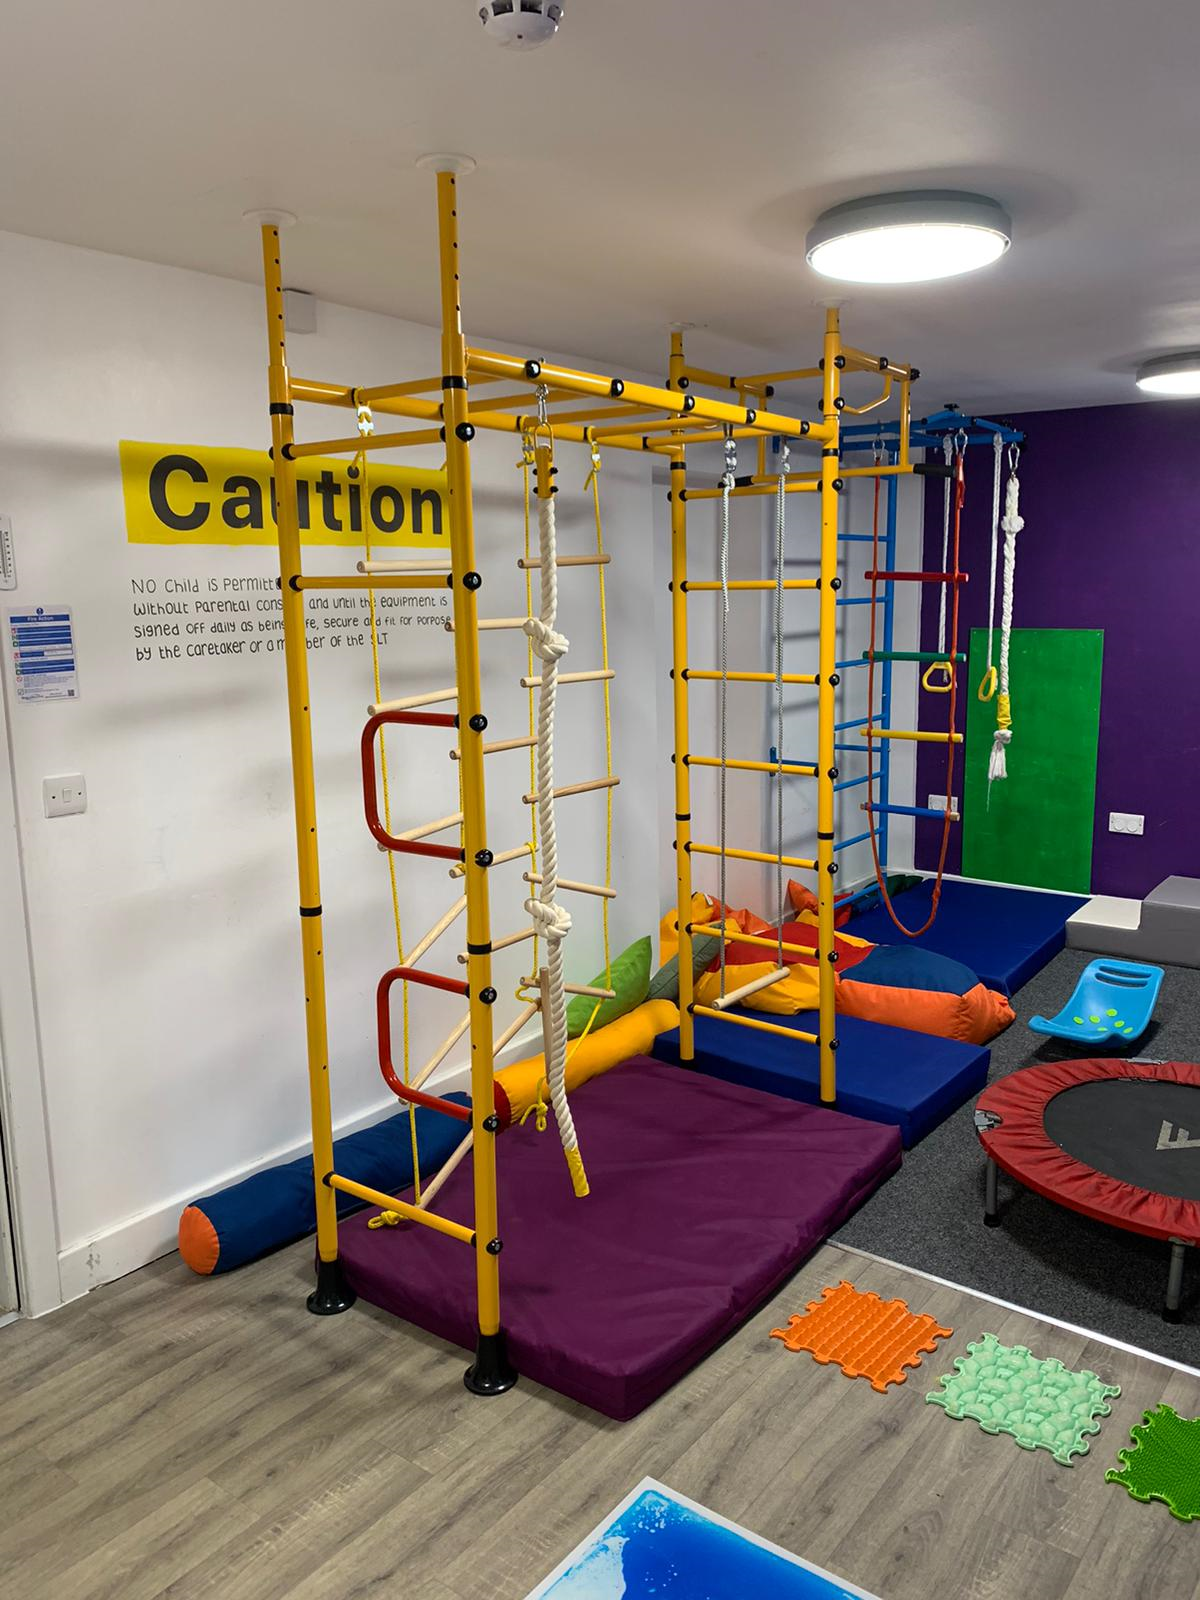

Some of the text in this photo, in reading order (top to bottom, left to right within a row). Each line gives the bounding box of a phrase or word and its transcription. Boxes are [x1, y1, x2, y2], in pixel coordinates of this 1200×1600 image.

[149, 454, 443, 535] Caution
[131, 578, 157, 594] NO
[164, 578, 200, 593] Child
[207, 578, 219, 591] is
[133, 601, 190, 616] Without
[195, 600, 250, 613] Parental
[309, 597, 329, 609] and
[333, 597, 356, 609] until
[380, 596, 436, 608] equipment
[440, 595, 448, 607] is
[134, 623, 180, 638] signed
[210, 620, 236, 633] daily
[240, 620, 254, 632] as
[323, 616, 360, 629] secure
[384, 616, 396, 626] fit
[400, 615, 413, 626] for
[135, 647, 152, 662] by
[158, 644, 182, 659] the
[186, 639, 247, 658] caretaker
[249, 639, 263, 653] or
[266, 639, 275, 652] a
[346, 633, 364, 647] the
